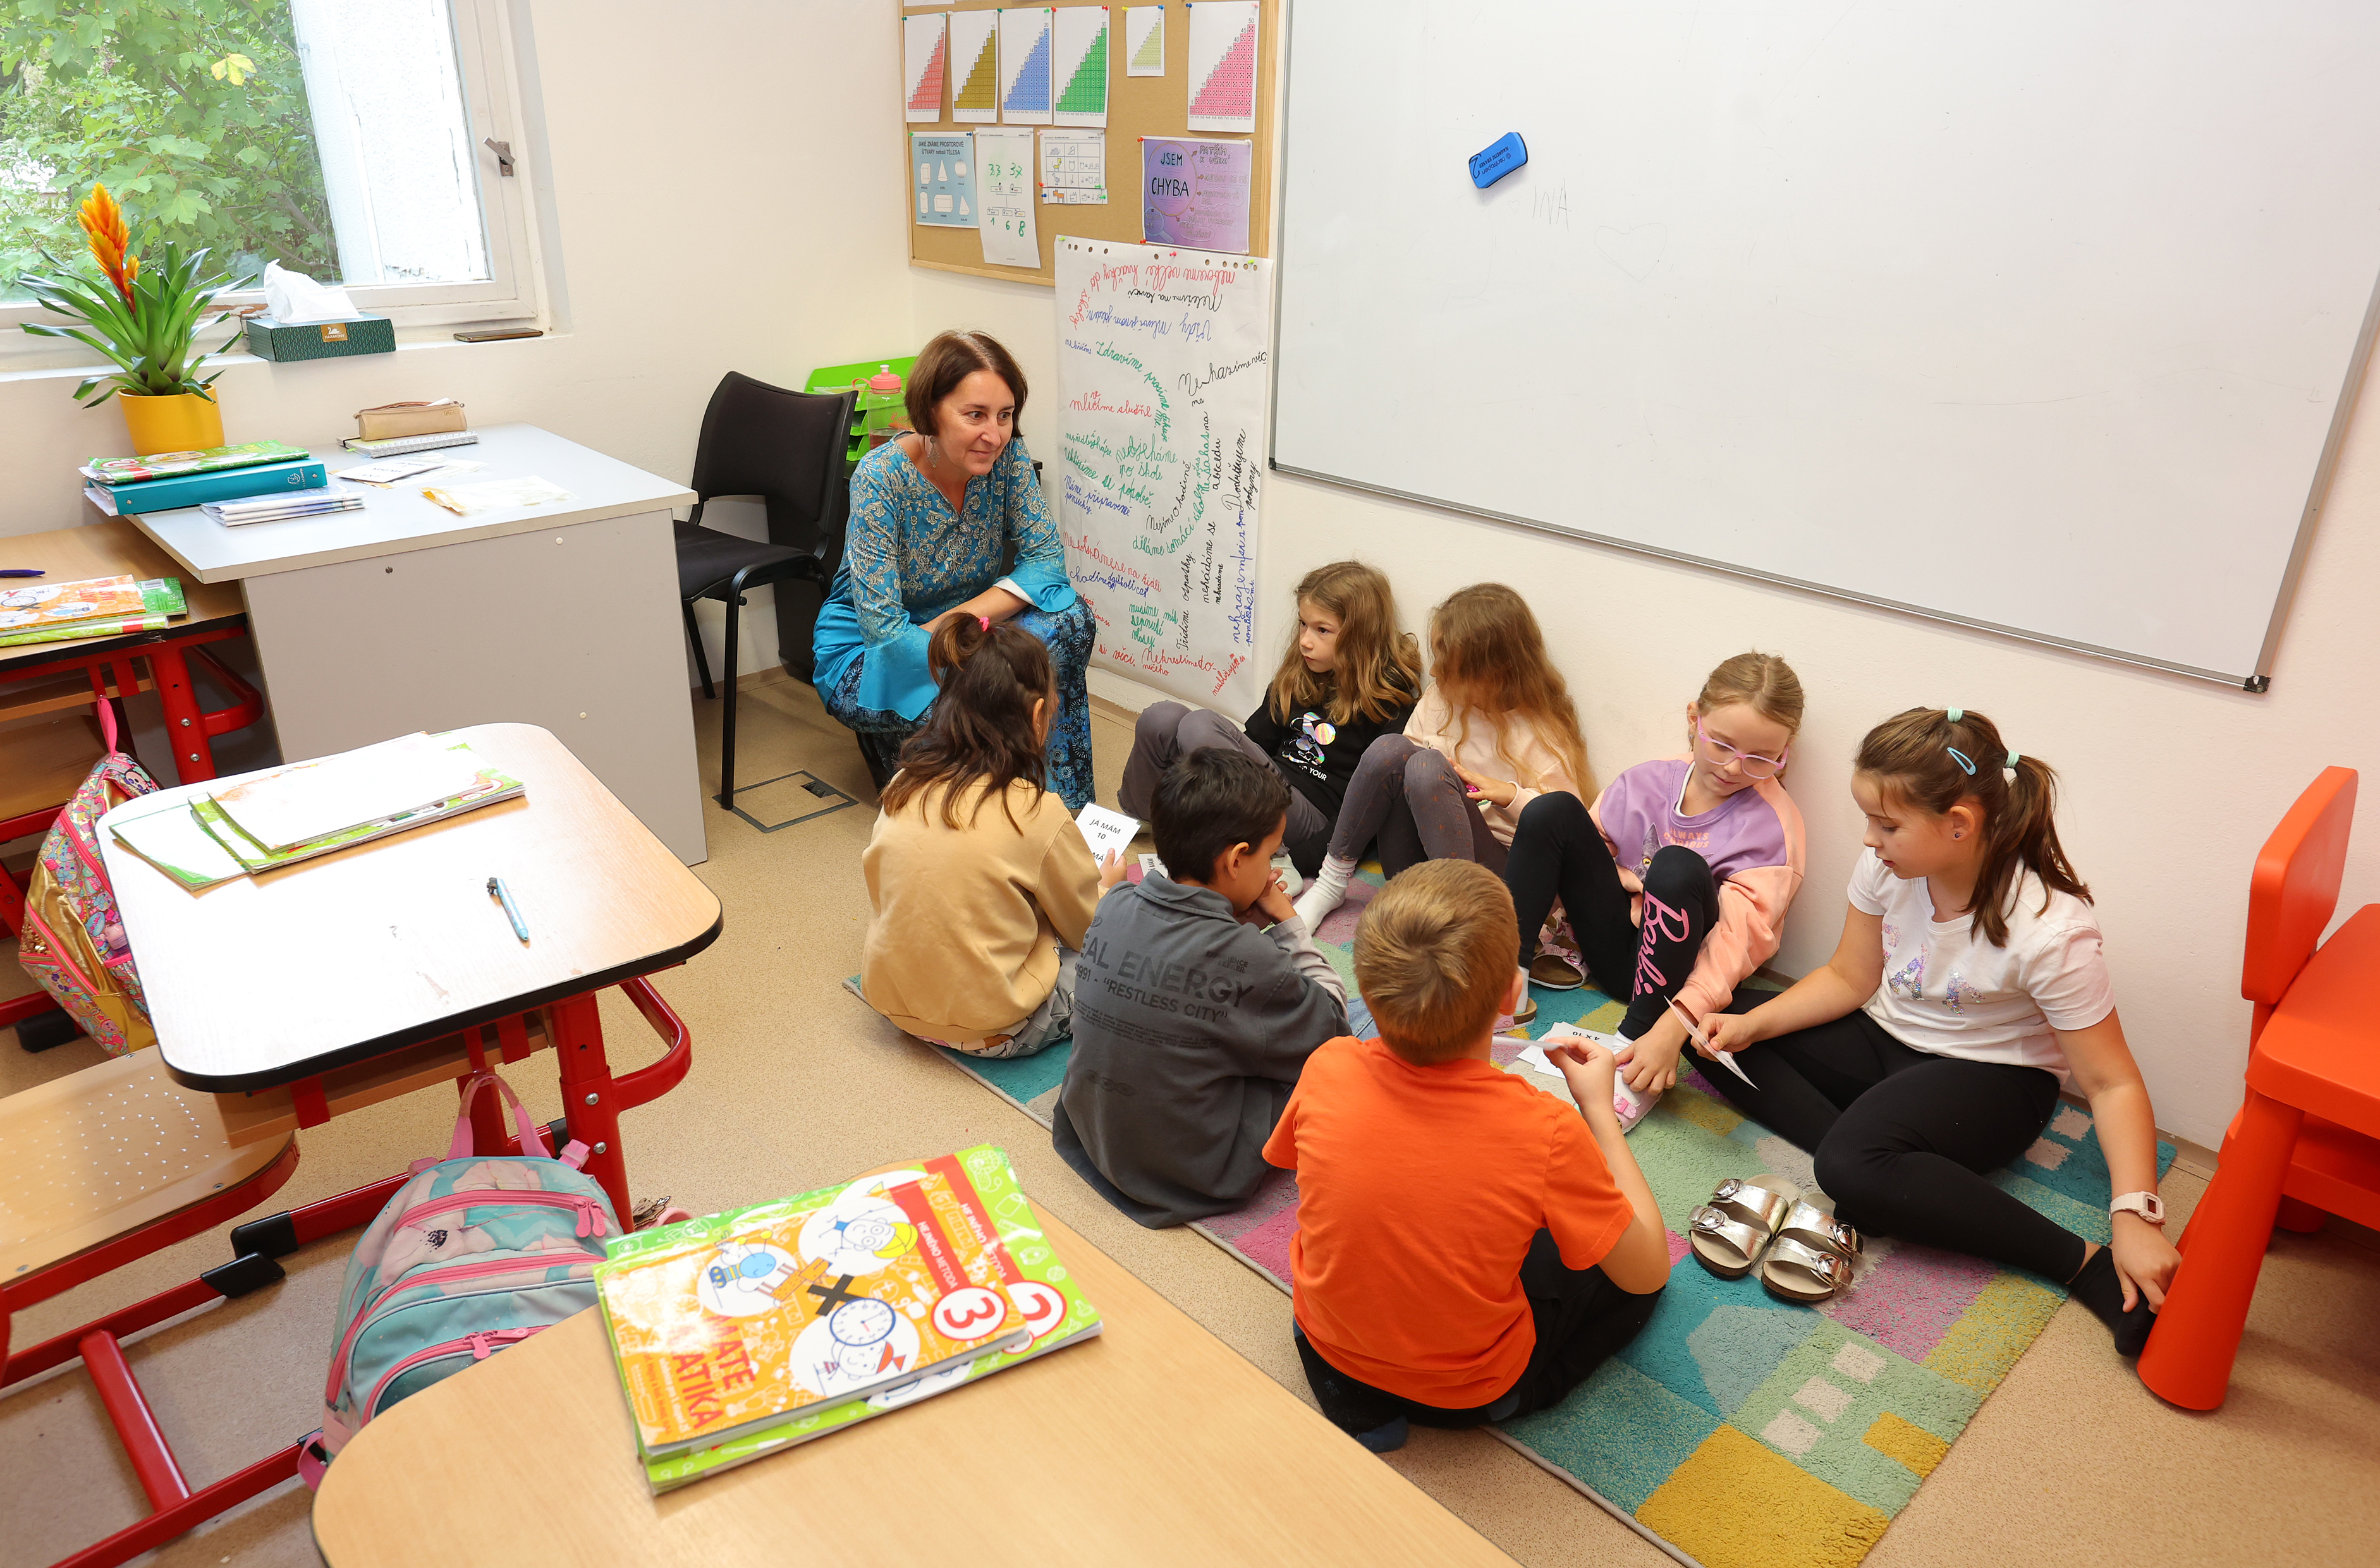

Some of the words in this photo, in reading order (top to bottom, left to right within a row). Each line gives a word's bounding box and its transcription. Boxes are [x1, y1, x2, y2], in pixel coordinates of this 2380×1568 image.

[1161, 152, 1183, 166] JSEM
[1199, 144, 1227, 155] PATŘÍM
[1209, 155, 1231, 165] UČENÍ
[1151, 177, 1190, 197] CHYBA
[991, 217, 995, 226] 1
[1006, 221, 1010, 230] 6
[1018, 221, 1026, 237] 8
[1090, 272, 1101, 292] do
[1103, 263, 1138, 291] hračky
[1145, 264, 1181, 291] velké
[1183, 267, 1236, 296] nebereme
[1179, 312, 1212, 343] Vždy
[1096, 341, 1142, 372] Zdravíme
[1176, 609, 1190, 650] Třídíme
[1309, 767, 1327, 781] YOUR
[1089, 818, 1099, 827] JÁ
[1101, 822, 1121, 834] MÁM
[1632, 889, 1690, 1002] Barbie
[1117, 951, 1255, 1008] ENERGY
[917, 1221, 942, 1257] HEJNÉHO
[934, 1256, 959, 1290] METODA
[943, 1296, 996, 1329] 3
[703, 1314, 757, 1390] MATE
